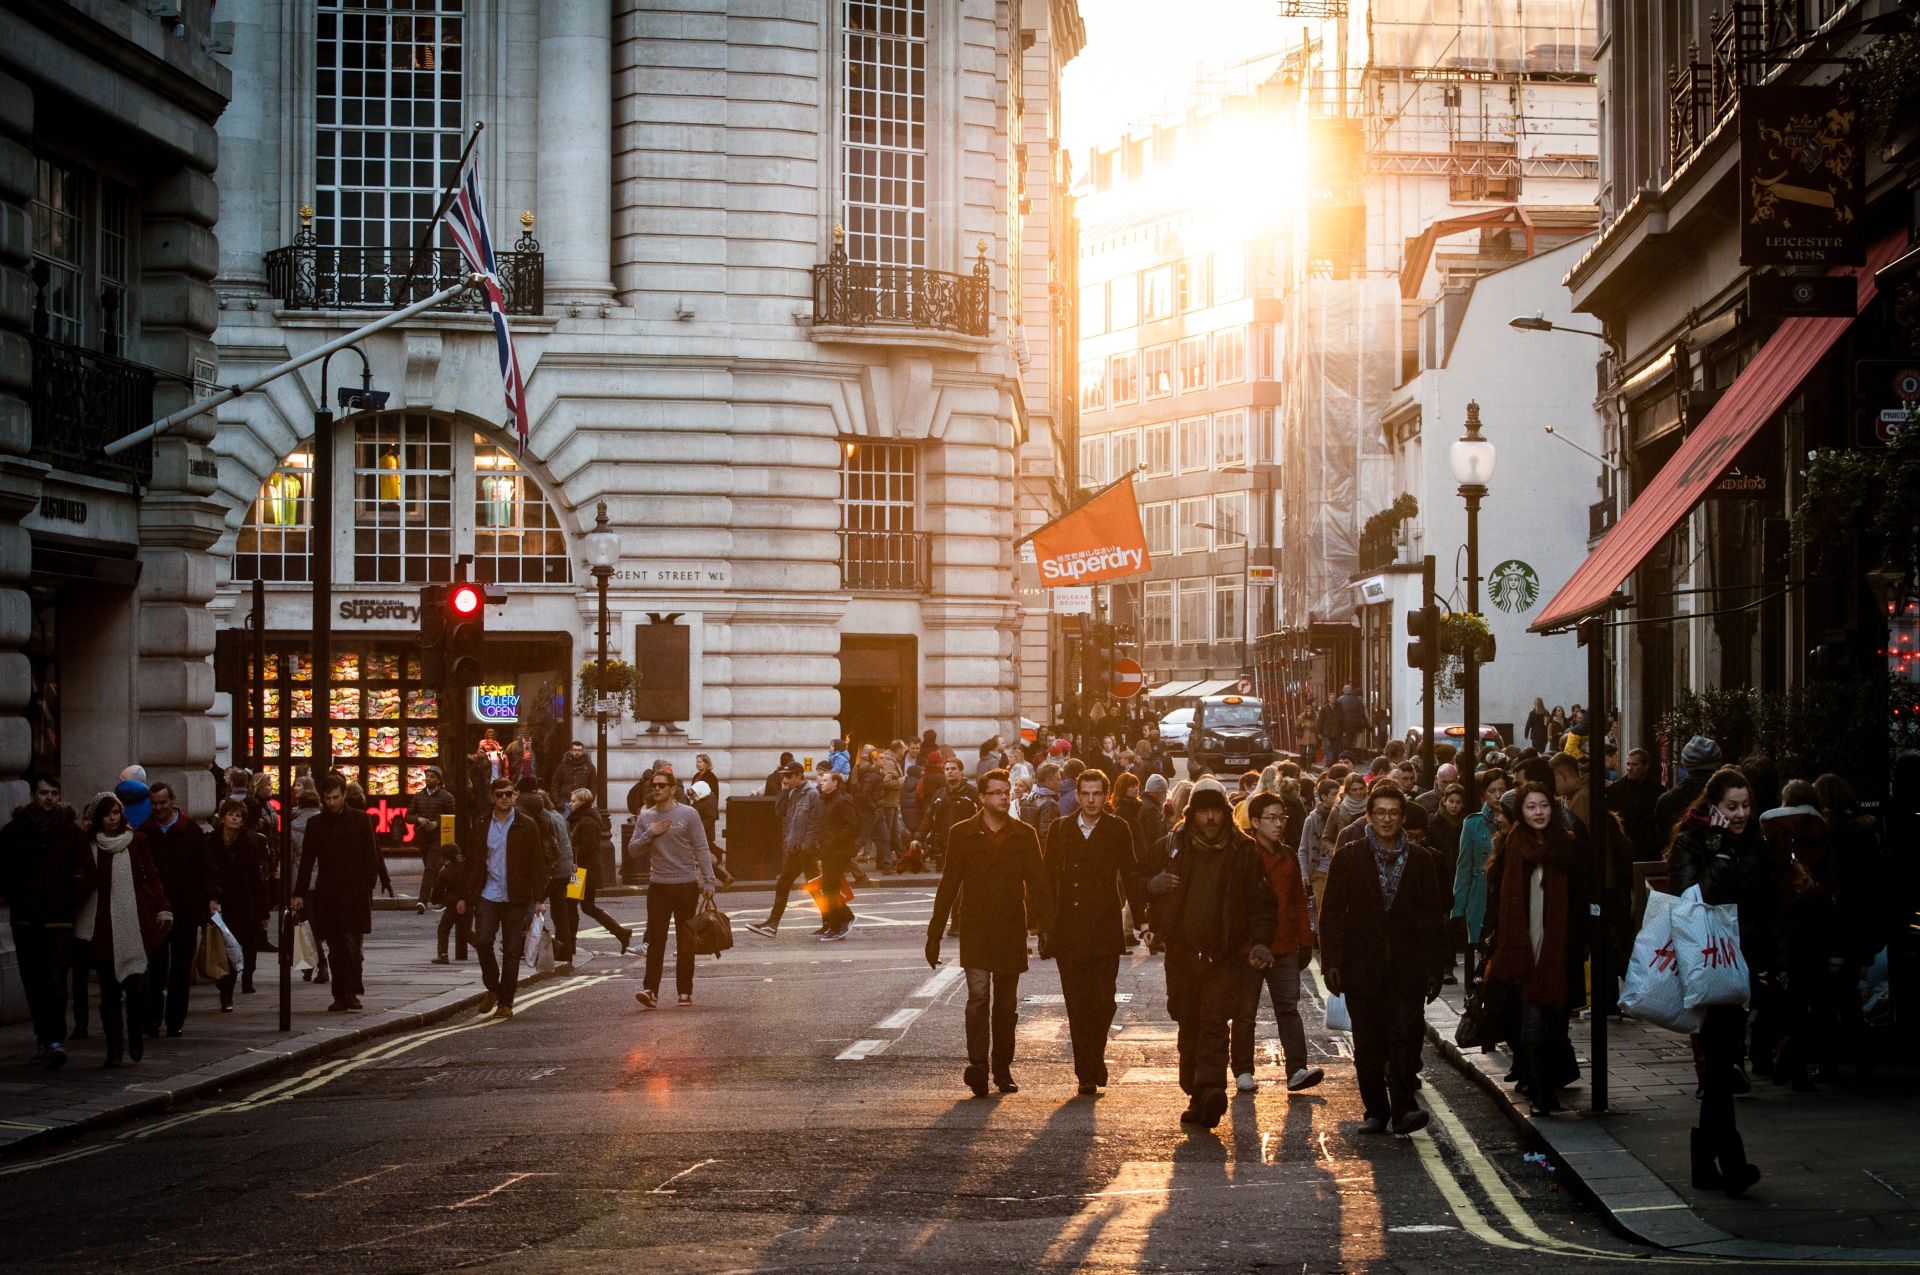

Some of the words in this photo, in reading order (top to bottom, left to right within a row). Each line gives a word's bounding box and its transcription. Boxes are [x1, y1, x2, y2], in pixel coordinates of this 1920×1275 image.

[1765, 236, 1843, 248] LEICESTER
[1785, 250, 1825, 260] ARMS
[1716, 474, 1766, 490] ando's
[1042, 546, 1143, 579] Superdry
[609, 571, 648, 581] EGENT
[658, 571, 702, 581] STREET
[1019, 588, 1044, 596] EIS
[340, 601, 421, 623] Superdry
[480, 684, 516, 696] T-SHIRT
[481, 695, 520, 706] GALLERY
[1701, 934, 1739, 971] H&M
